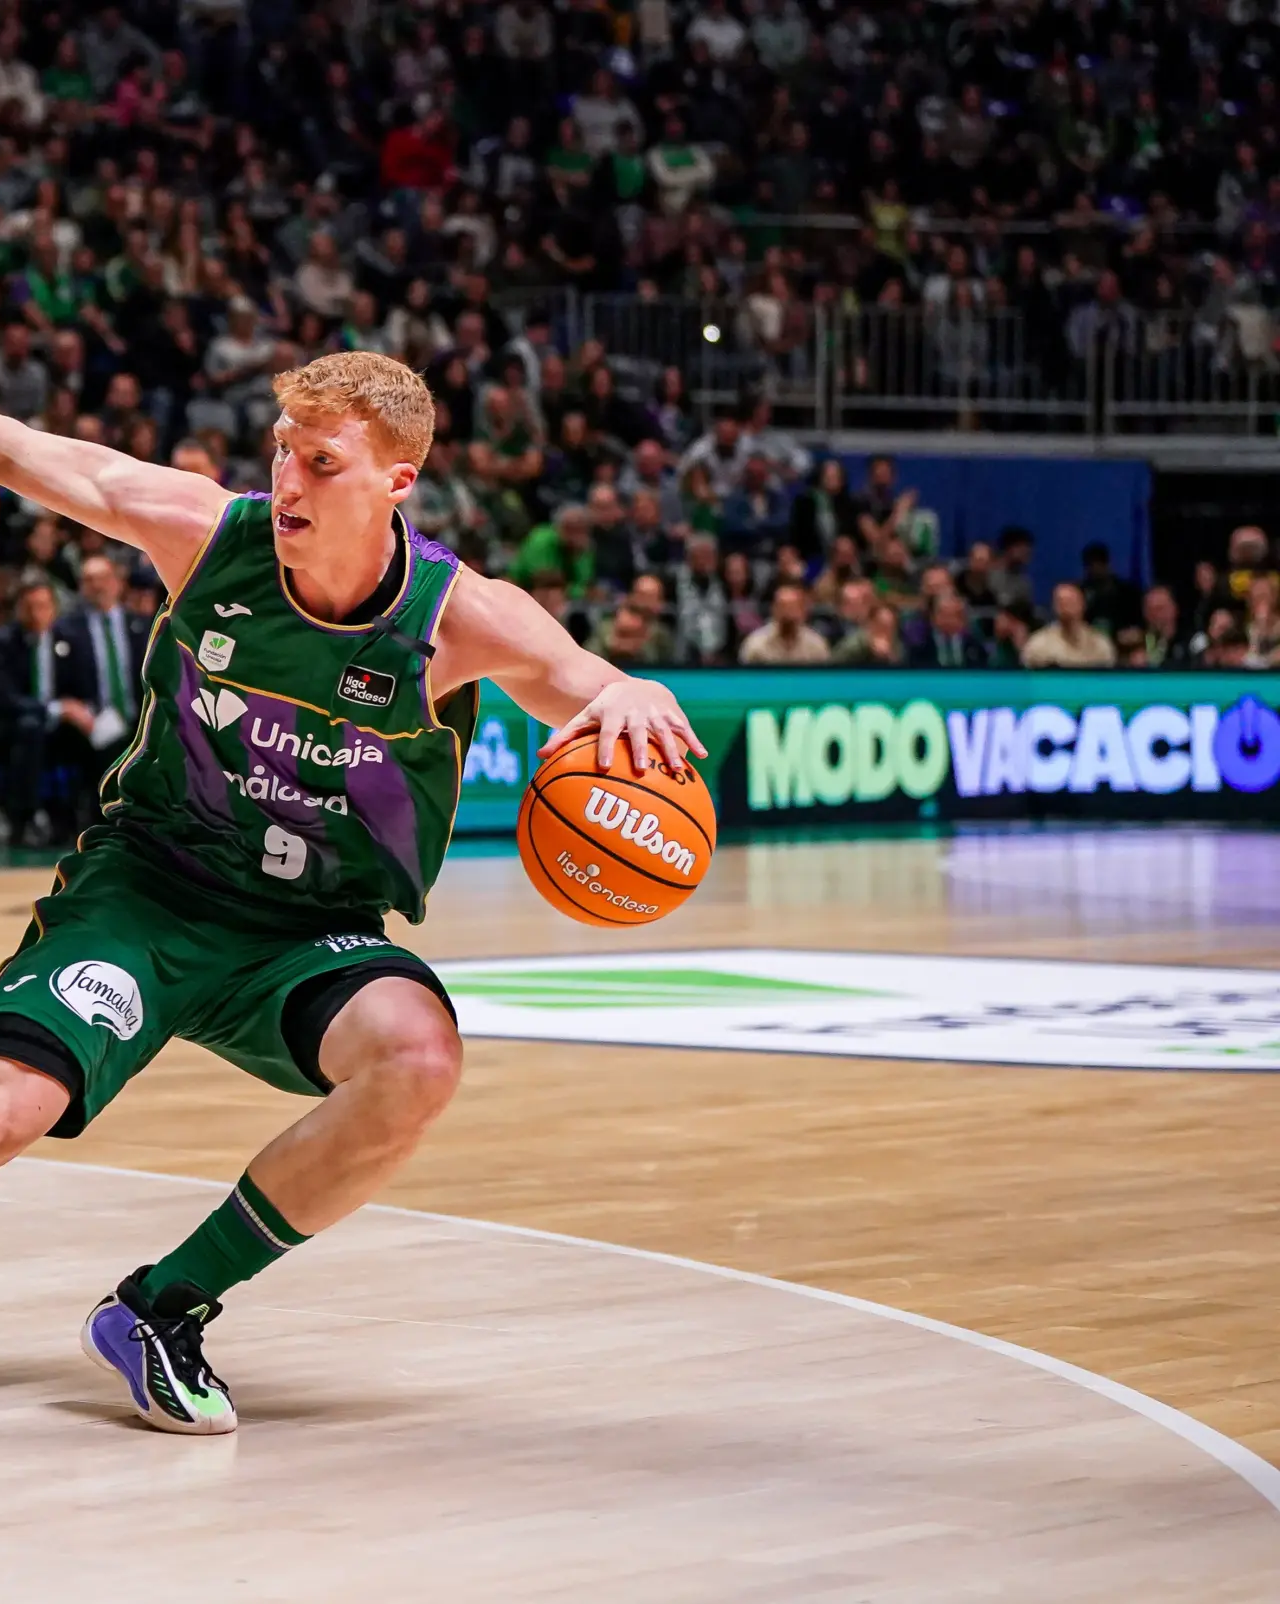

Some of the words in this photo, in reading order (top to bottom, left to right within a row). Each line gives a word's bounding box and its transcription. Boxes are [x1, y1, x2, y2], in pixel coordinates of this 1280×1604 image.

[343, 686, 388, 704] endesa
[345, 675, 367, 690] liga
[250, 717, 384, 769] Unicaja
[746, 698, 949, 811] MODO
[261, 824, 308, 880] 9
[583, 785, 696, 876] Wilson
[555, 850, 591, 885] liga
[588, 881, 660, 915] endesa
